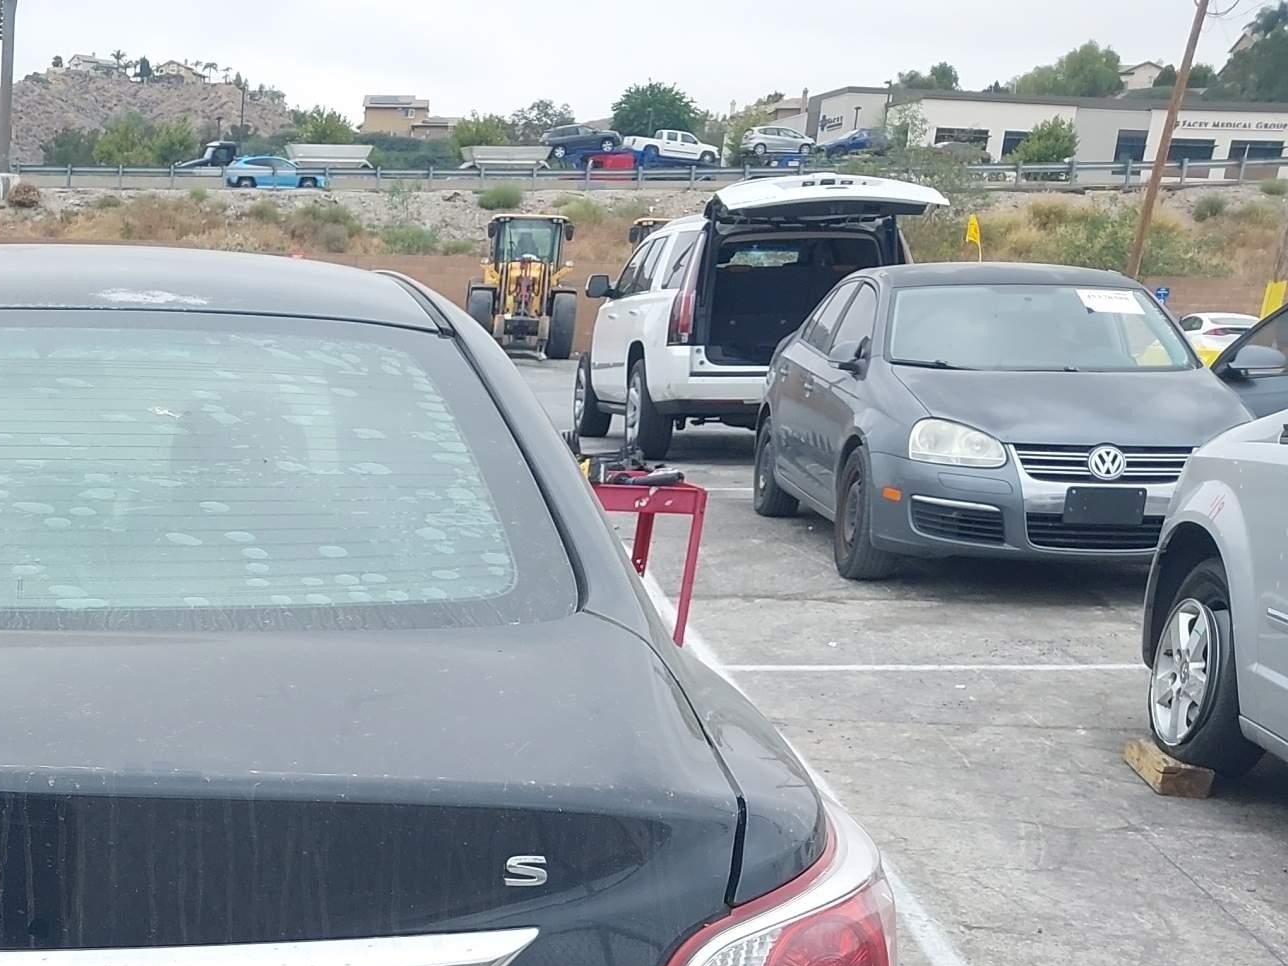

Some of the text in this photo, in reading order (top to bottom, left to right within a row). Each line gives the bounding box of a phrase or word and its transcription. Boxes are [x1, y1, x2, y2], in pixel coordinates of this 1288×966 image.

[1182, 120, 1288, 130] FACEY MEDICAL GROUP
[504, 855, 548, 887] S
